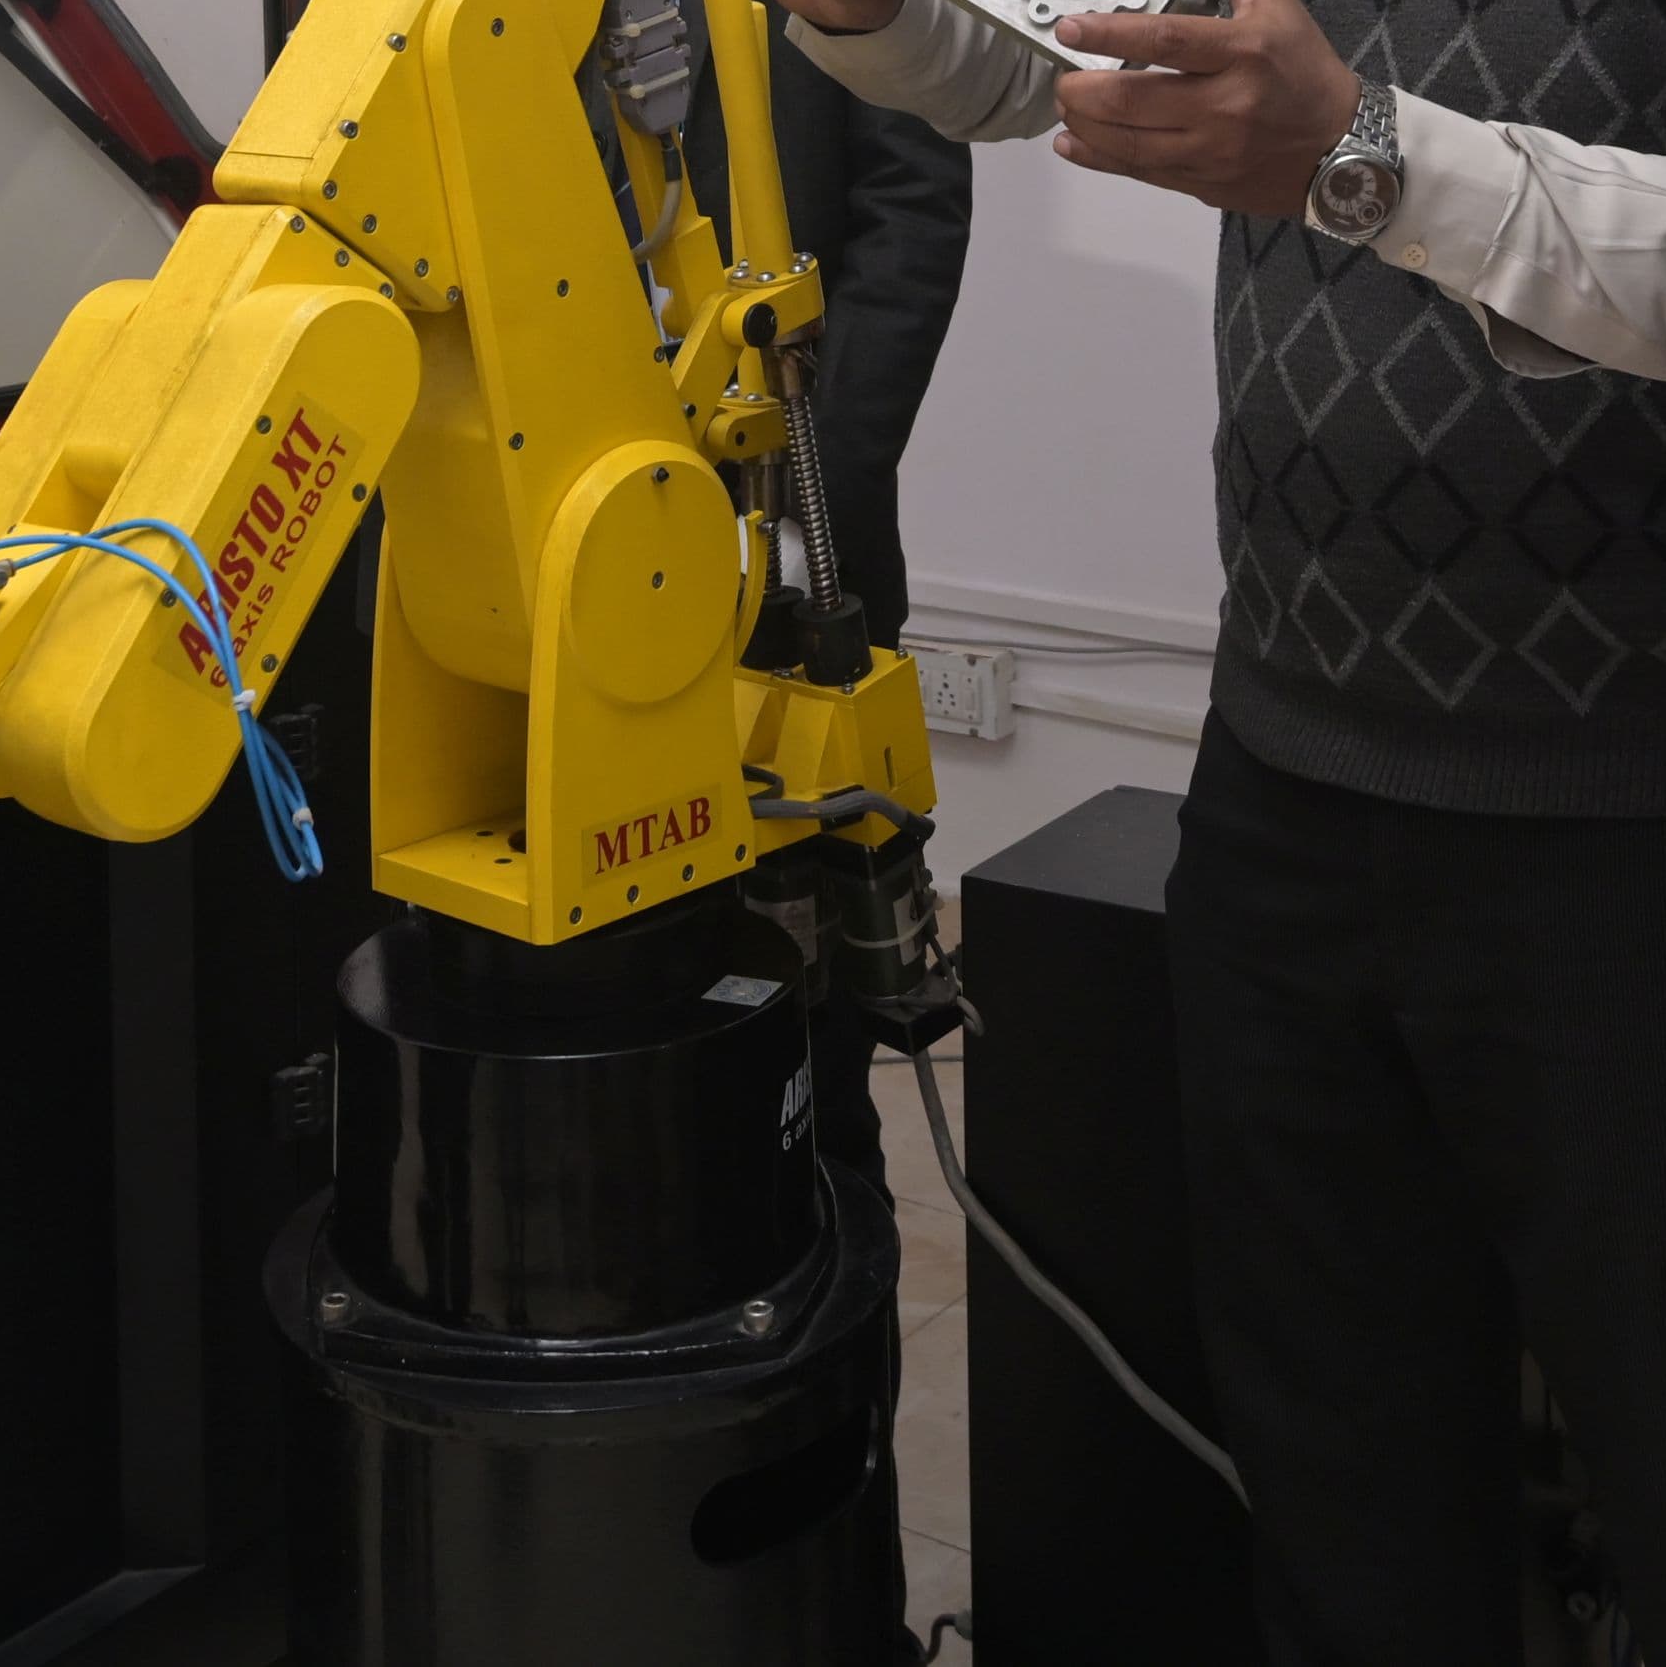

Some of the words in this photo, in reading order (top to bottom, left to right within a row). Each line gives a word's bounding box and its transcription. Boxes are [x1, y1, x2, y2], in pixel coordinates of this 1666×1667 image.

[271, 407, 323, 492] XT
[210, 664, 229, 688] 6
[232, 583, 275, 658] axis
[270, 434, 347, 573] ROBOT
[594, 796, 712, 875] MTAB
[782, 1131, 792, 1151] 6
